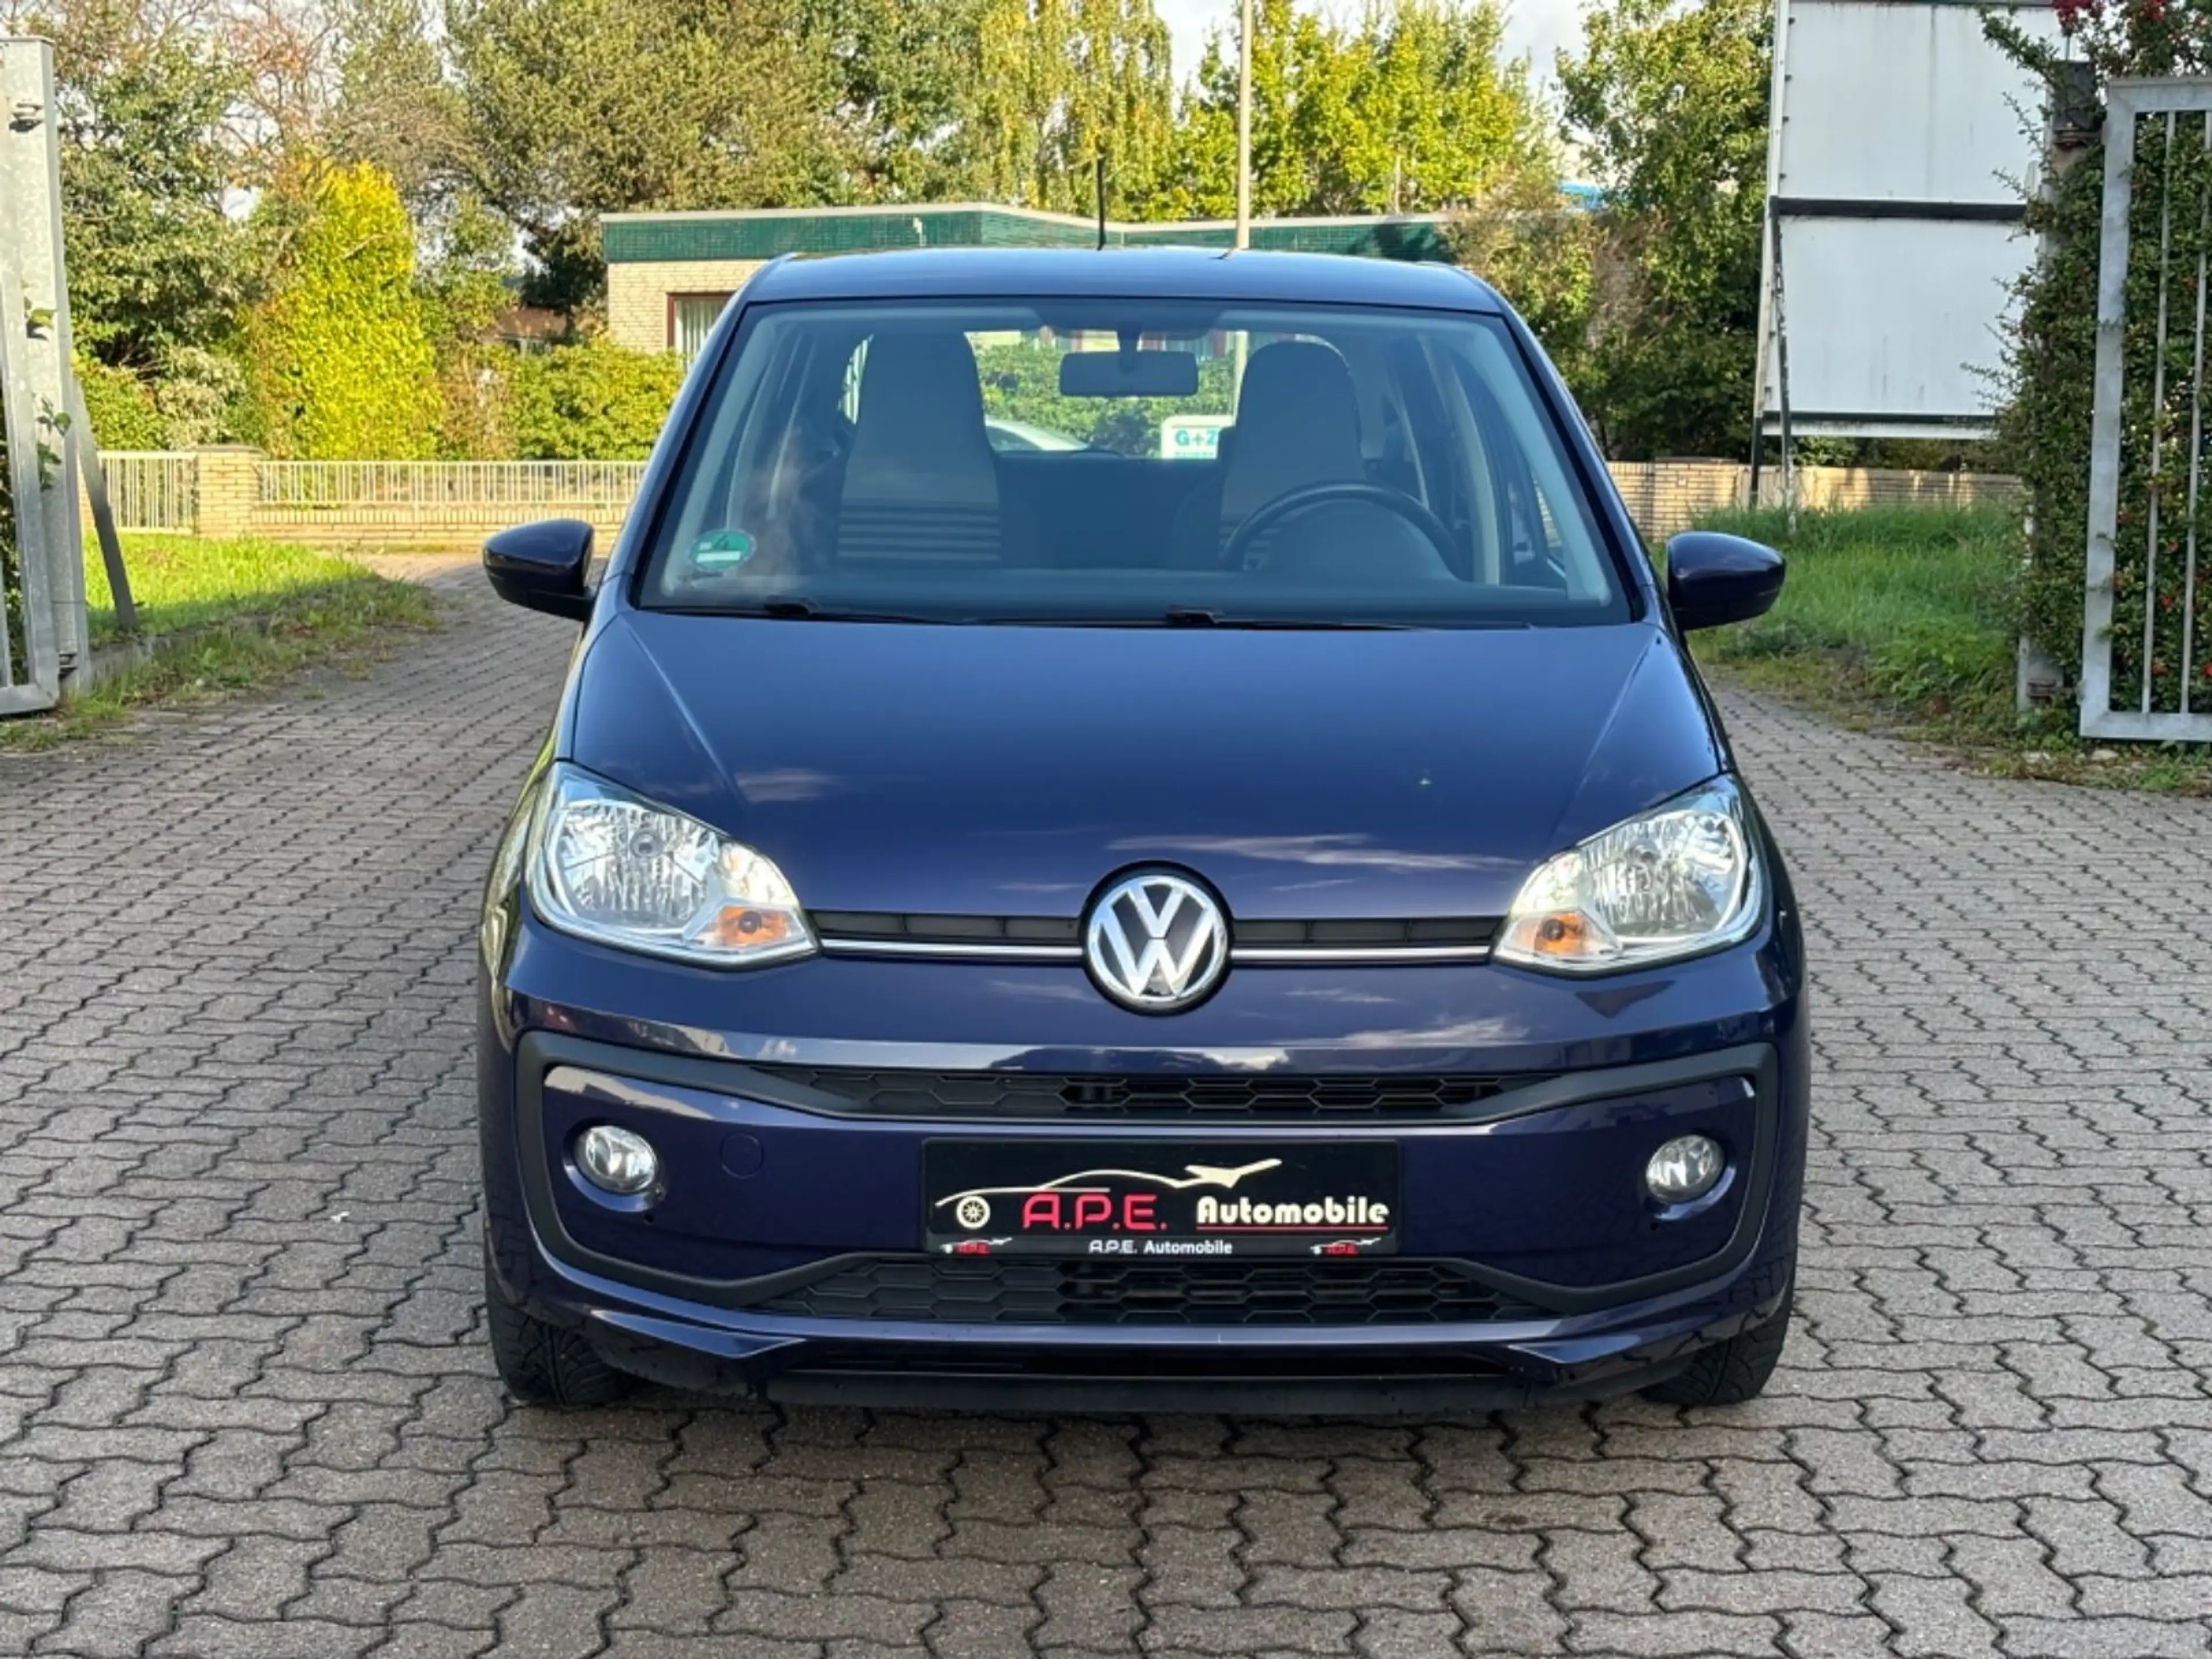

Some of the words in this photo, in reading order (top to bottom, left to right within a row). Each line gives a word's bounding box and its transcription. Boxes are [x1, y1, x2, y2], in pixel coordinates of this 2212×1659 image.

[1093, 879, 1215, 998] VW
[1022, 1194, 1168, 1230] A.P.E.
[1196, 1195, 1389, 1224] Automobile
[1089, 1239, 1138, 1254] A.P.E.
[1143, 1239, 1233, 1254] Automobile
